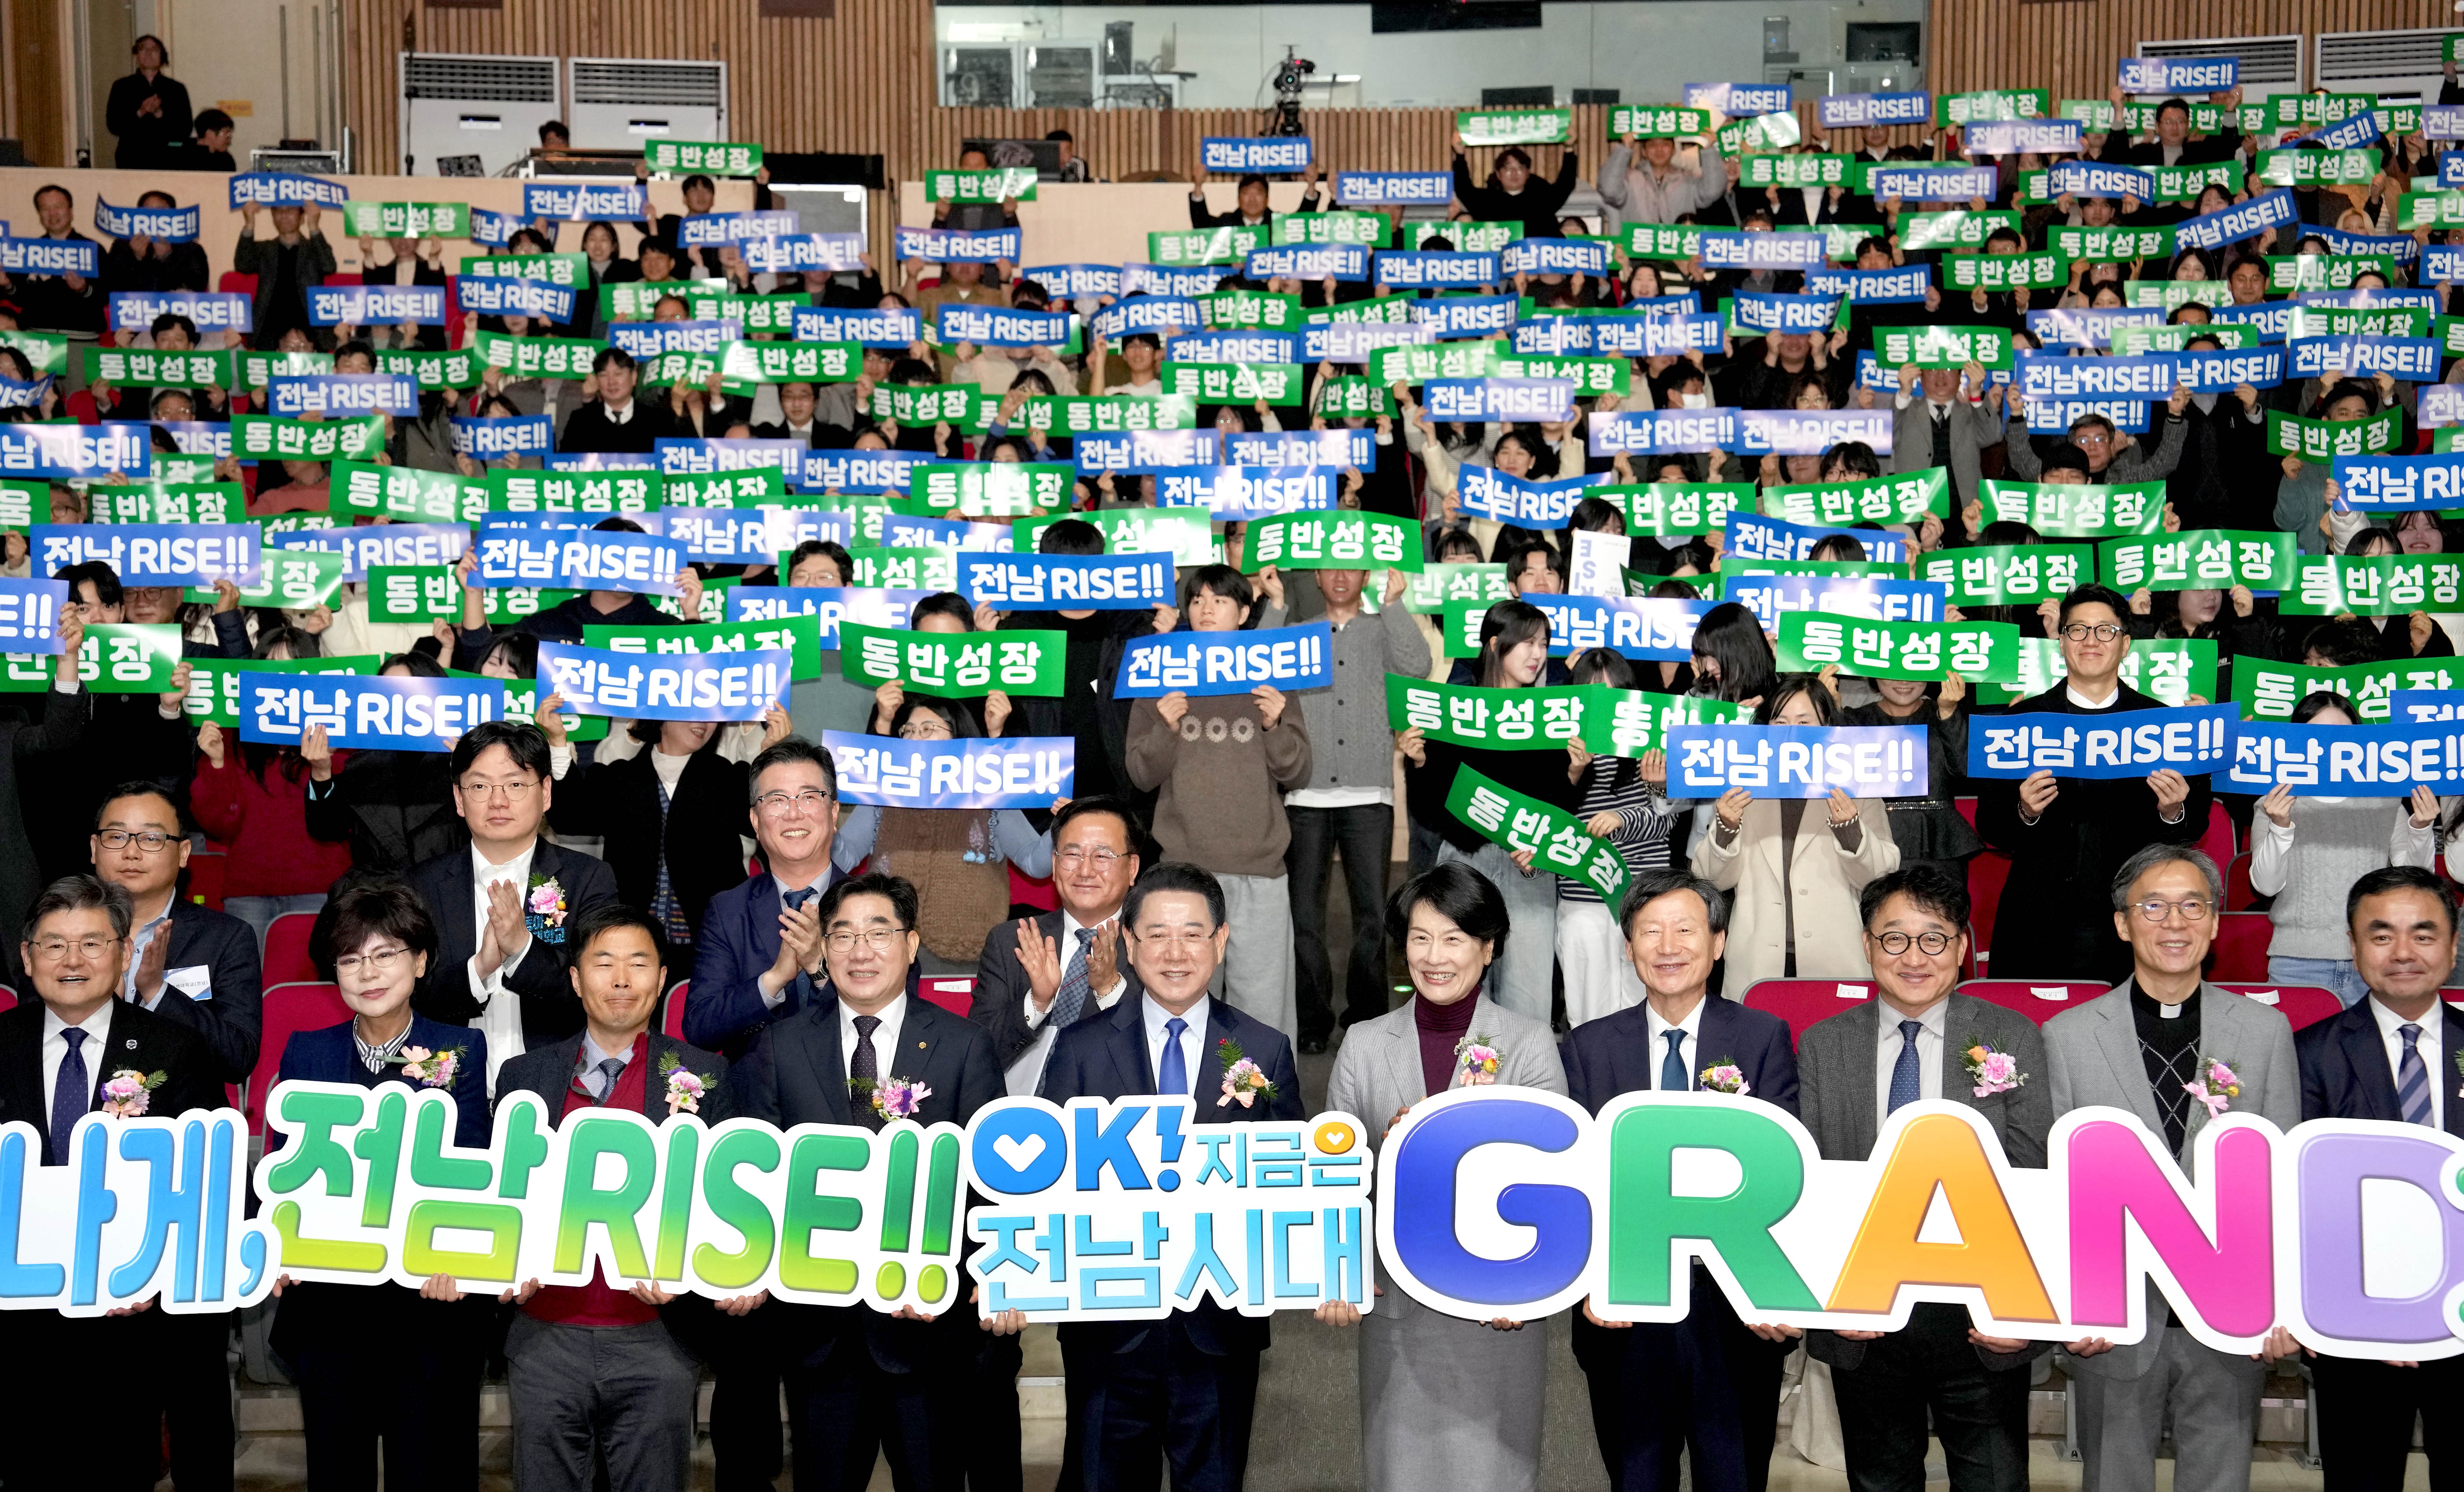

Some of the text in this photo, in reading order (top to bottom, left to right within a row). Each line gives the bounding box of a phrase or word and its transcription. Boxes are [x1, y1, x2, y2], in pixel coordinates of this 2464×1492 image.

[2126, 64, 2231, 87] 전남 RISE!!
[1735, 89, 1787, 110] RISE!!
[1825, 97, 1924, 123] 전남 RISE!!
[1468, 115, 1558, 138] 동반성장
[1614, 110, 1699, 133] 동반성장
[2015, 125, 2077, 146] RISE!!
[657, 145, 750, 168] 동반성장
[1206, 143, 1307, 168] 전남 RISE!!
[1752, 159, 1842, 181] 동반성장
[2268, 156, 2366, 178] 동반성장
[234, 179, 344, 205] 전남 RISE!!
[1343, 177, 1447, 199] 전남 RISE!!
[1882, 174, 1924, 197] 전남
[1927, 175, 1990, 195] RISE!!
[2051, 168, 2149, 197] 전남 RISE!!
[530, 190, 641, 215] 전남 RISE!!
[2221, 195, 2290, 237] RISE!!
[133, 214, 196, 238] RISE!!
[356, 207, 456, 233] 동반성장
[684, 218, 792, 243] 전남 RISE!!
[1285, 217, 1379, 241] 동반성장
[27, 246, 91, 271] RISE!!
[793, 241, 859, 263] RISE!!
[902, 232, 1015, 259] 전남 RISE!!
[1502, 246, 1538, 273] 전남
[1539, 243, 1601, 269] RISE!!
[1705, 239, 1820, 263] 전남 RISE!!
[2060, 232, 2162, 258] 동반성장
[1251, 250, 1361, 273] 전남 RISE!!
[1380, 259, 1492, 283] 전남 RISE!!
[1955, 256, 2055, 284] 동반성장
[461, 281, 570, 315] 전남 RISE!!
[1861, 272, 1925, 297] RISE!!
[315, 293, 438, 320] 전남 RISE!!
[1129, 302, 1197, 328] RISE!!
[1450, 300, 1515, 330] RISE!!
[1740, 298, 1783, 329] 전남
[796, 314, 842, 341] 전남
[845, 315, 916, 341] RISE!!
[944, 311, 992, 340] 전남
[994, 315, 1064, 340] RISE!!
[1516, 326, 1556, 352] 전남
[1597, 322, 1717, 350] 전남 RISE!!
[2034, 318, 2083, 342] 전남
[488, 339, 597, 372] 동반성장
[614, 329, 662, 356] 전남
[1223, 339, 1291, 363] RISE!!
[1306, 332, 1354, 356] 전남
[2297, 342, 2432, 373] 전남 RISE!!
[99, 354, 216, 384] 동반성장
[737, 347, 848, 376] 동반성장
[2204, 353, 2279, 385] RISE!!
[2025, 363, 2167, 395] 전남 RISE!!
[276, 382, 409, 411] 전남 RISE!!
[873, 388, 968, 420] 동반성장
[1430, 384, 1565, 415] 전남 RISE!!
[246, 422, 368, 454] 동반성장
[476, 421, 546, 452] RISE!!
[1598, 416, 1733, 449] 전남 RISE!!
[1744, 419, 1799, 448] 전남
[2281, 419, 2389, 456] 동반성장
[42, 435, 140, 469] RISE!!
[663, 445, 714, 476] 전남
[1080, 439, 1129, 469] 전남
[804, 458, 848, 487] 전남
[2345, 466, 2418, 502] 전남
[349, 471, 488, 521] 동반성장
[507, 478, 647, 512] 동반성장
[1464, 474, 1519, 518] 전남
[1784, 479, 1929, 525] 동반성장
[1998, 490, 2145, 528] 동반성장
[360, 533, 462, 566] RISE!!
[670, 518, 738, 554] 전남
[1256, 520, 1405, 562] 동반성장
[131, 536, 249, 574] RISE!!
[482, 538, 677, 581] 전남 RISE!!
[2115, 540, 2275, 586] 동반성장
[970, 563, 1164, 602] 전남 RISE!!
[2300, 564, 2459, 605] 동반성장
[862, 635, 1041, 687] 동반성장
[1128, 635, 1322, 687] 전남 RISE!!
[1802, 621, 1994, 671] 동반성장
[552, 658, 777, 708] 전남 RISE!!
[255, 687, 350, 737] 전남
[1406, 687, 1584, 740] 동반성장
[1984, 717, 2224, 769] 전남 RISE!!
[836, 746, 1060, 796] 전남 RISE!!
[1681, 738, 1913, 786] 전남 RISE!!
[2230, 736, 2324, 784] 전남
[1467, 787, 1623, 895] 동반성장
[973, 1106, 1361, 1195] OK! 지금은
[268, 1092, 960, 1304] 전남 RISE!!
[1394, 1099, 2464, 1343] GRAND
[978, 1207, 1361, 1312] 전남 시대
